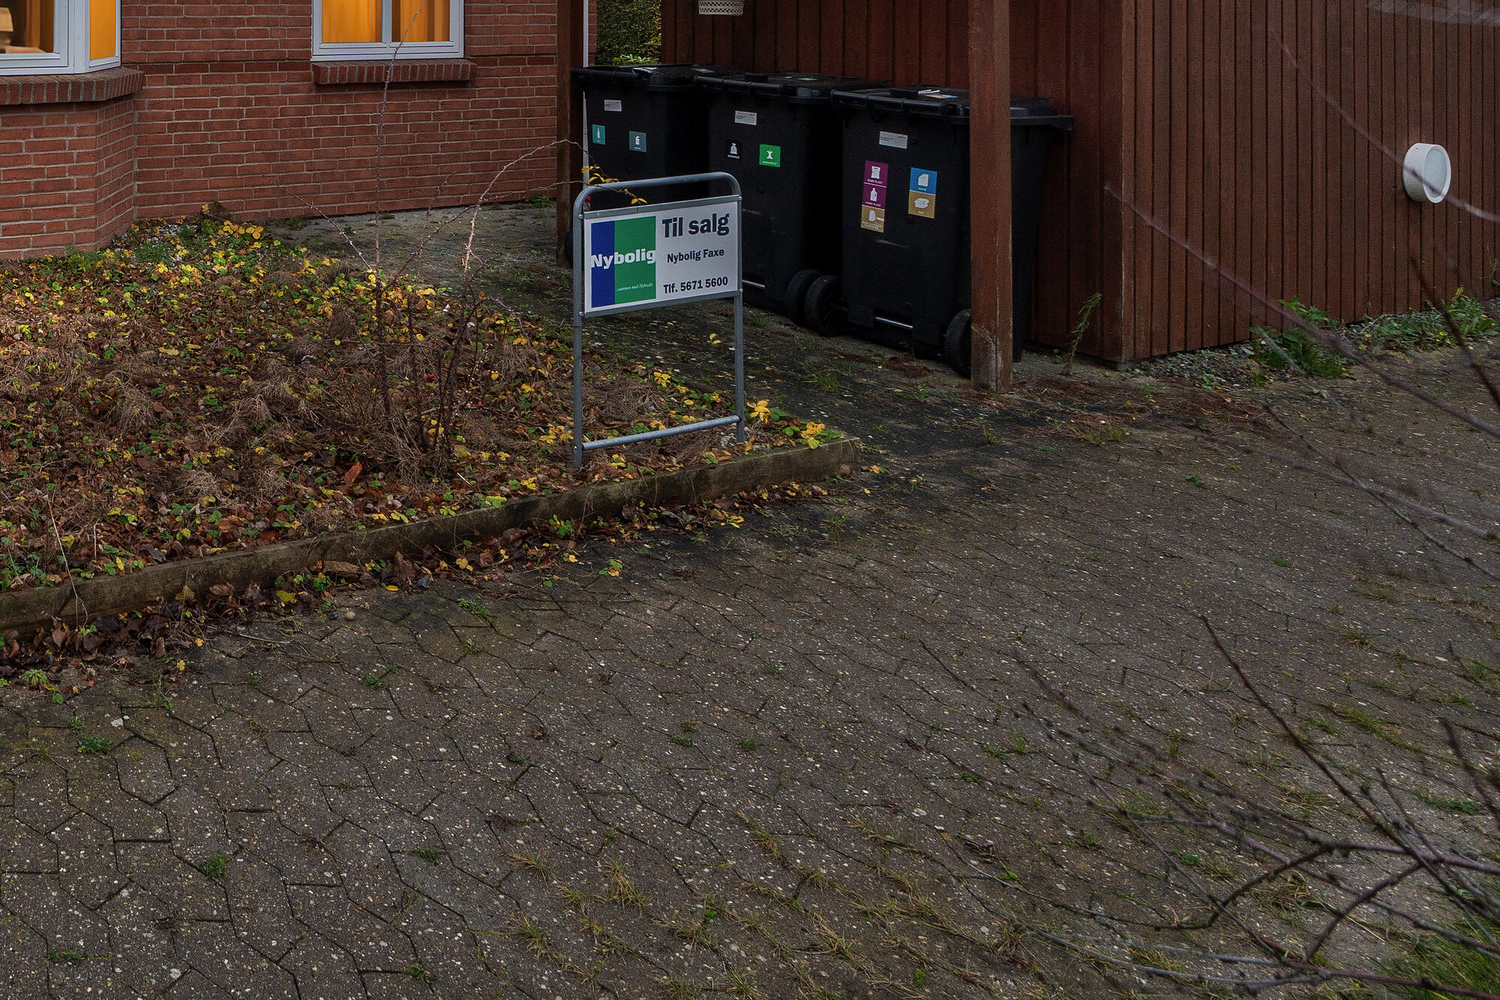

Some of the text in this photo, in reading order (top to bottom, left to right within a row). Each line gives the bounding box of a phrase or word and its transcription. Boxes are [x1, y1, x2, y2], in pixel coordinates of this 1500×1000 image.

[662, 213, 730, 238] Til salg
[591, 248, 656, 270] Nybolig
[667, 248, 725, 265] Nybolig Faxe
[663, 283, 678, 294] Tlf.
[680, 279, 703, 292] 5671
[705, 276, 729, 289] 5600
